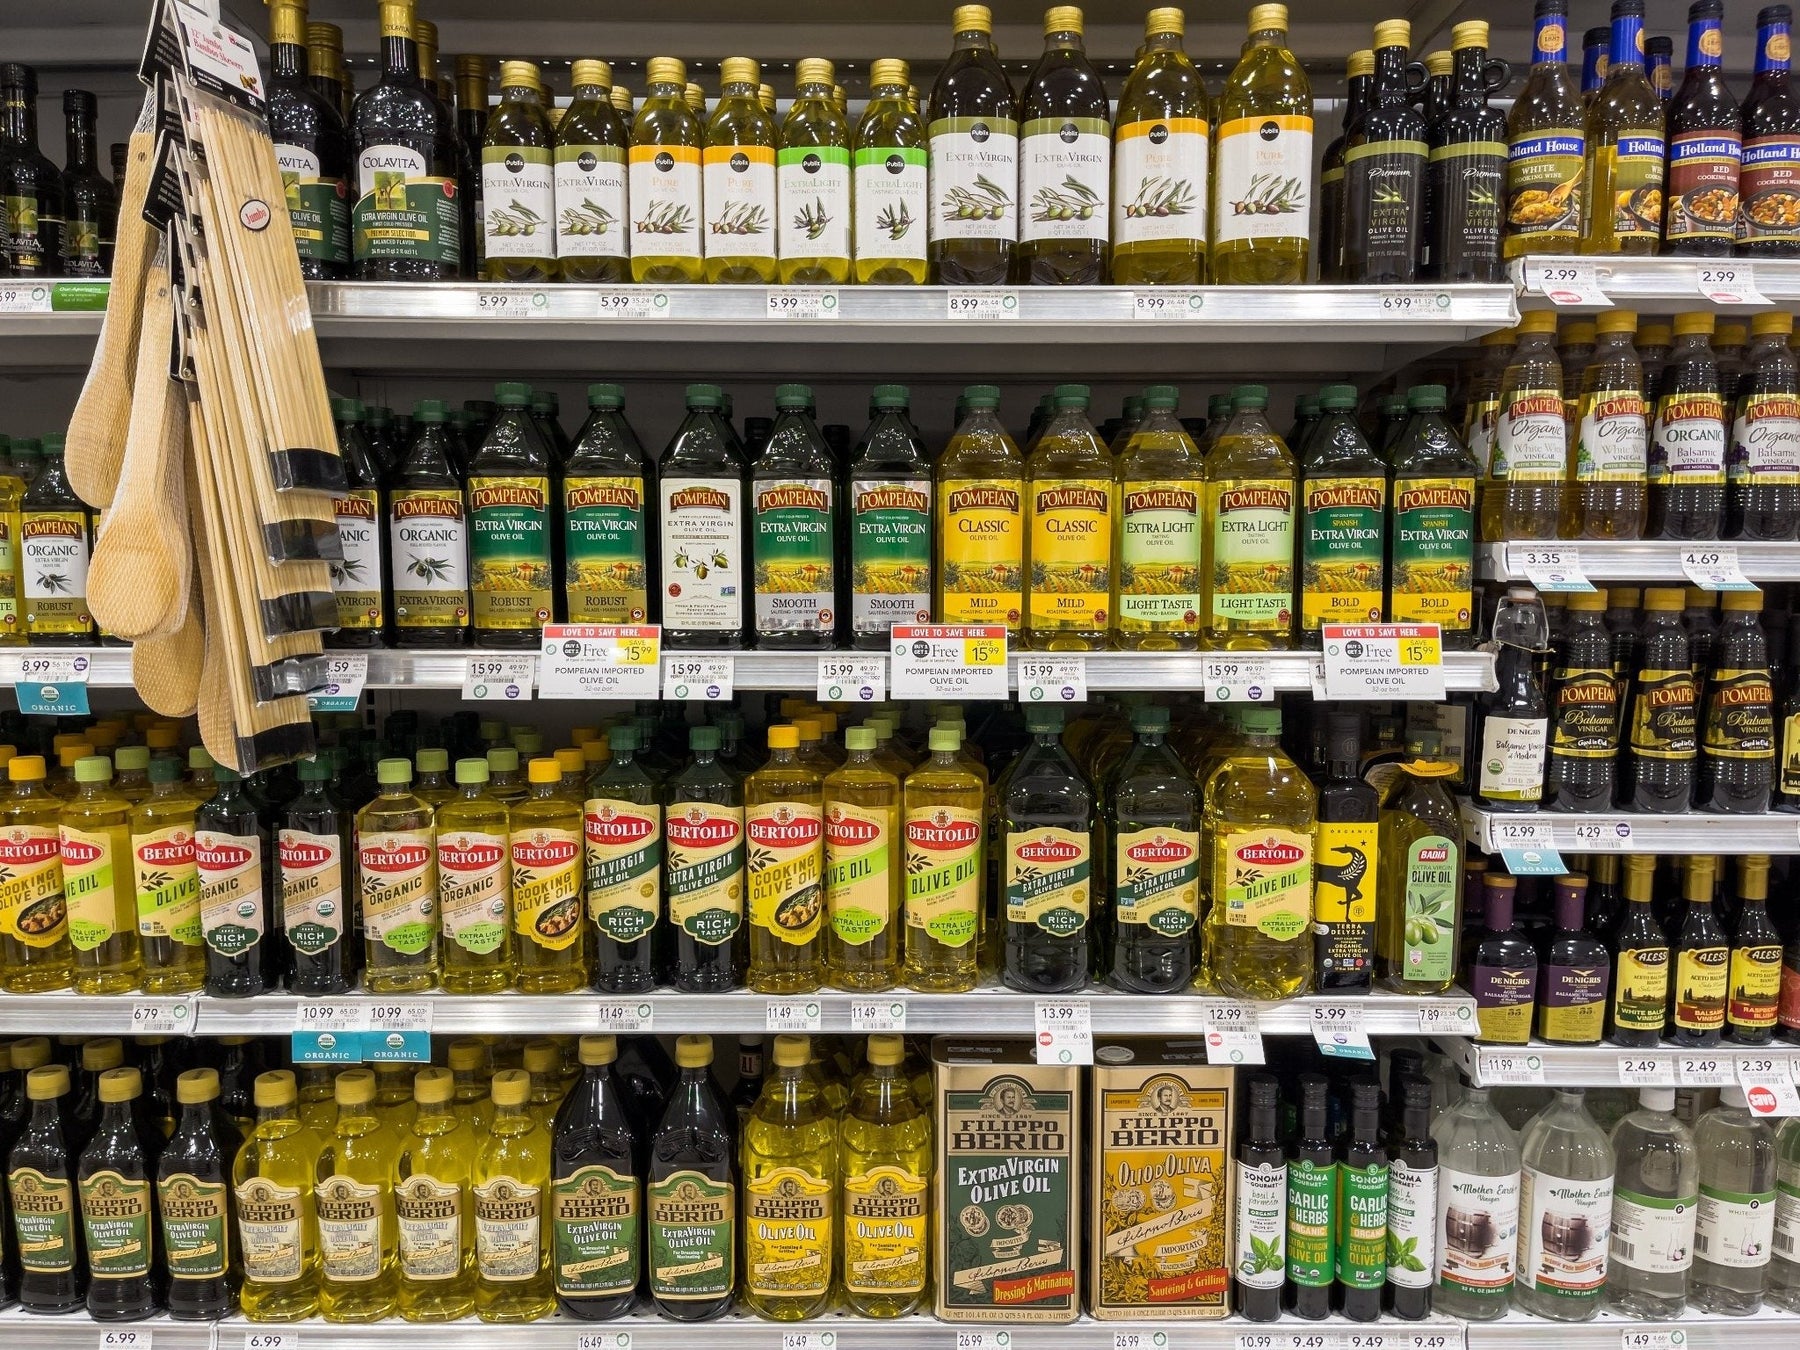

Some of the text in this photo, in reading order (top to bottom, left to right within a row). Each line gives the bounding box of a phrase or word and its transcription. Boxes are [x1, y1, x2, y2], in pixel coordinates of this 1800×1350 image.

[971, 129, 990, 137] Publix
[1510, 141, 1578, 157] olland House
[1680, 143, 1726, 157] Holland
[363, 156, 419, 170] COLAVITA
[1521, 163, 1555, 175] WHITE
[1713, 165, 1730, 173] RED
[1367, 166, 1412, 180] Premium
[1773, 170, 1793, 178] RED
[246, 209, 268, 225] Jumbo
[1373, 209, 1407, 218] EXTRA
[1371, 217, 1407, 226] VIRGIN
[1544, 269, 1577, 280] 2.99
[1702, 270, 1735, 282] 2.99
[1511, 419, 1562, 441] Organic
[1666, 429, 1723, 443] ORGANIC
[1677, 447, 1717, 458] Balsamic
[1757, 447, 1797, 459] Balsamic
[476, 488, 539, 506] POMPEIAN
[673, 491, 726, 507] POMPEIAN
[953, 491, 1015, 508] POMPEIAN
[1129, 493, 1193, 509] POMPEIAN
[1314, 491, 1378, 507] POMPEIAN
[397, 501, 458, 516] POMPEIAN
[475, 520, 542, 531] EXTRA VIRGIN
[958, 518, 1010, 534] CLASSIC
[1046, 518, 1098, 534] CLASSIC
[1126, 522, 1195, 534] EXTRA LIGHT
[400, 528, 457, 543] ORGANIC
[27, 545, 78, 557] ORGANIC
[1527, 553, 1561, 565] 3.35
[1686, 553, 1719, 565] 4.69
[37, 602, 73, 611] ROBUST
[490, 596, 532, 607] ROBUST
[772, 598, 817, 608] SMOOTH
[970, 598, 998, 609] MILD
[1057, 598, 1085, 609] MILD
[1126, 599, 1193, 609] LIGHT TASTE
[1331, 597, 1360, 607] BOLD
[563, 628, 641, 637] LOVE TO SAVE HERE.
[911, 629, 988, 637] LOVE TO SAVE HERE.
[1342, 628, 1421, 637] LOVE TO SAVE HERE.
[583, 644, 608, 657] Free
[555, 667, 645, 675] POMPEIAN IMPORTED
[905, 668, 993, 676] POMPEIAN IMPORTED
[1577, 725, 1608, 733] VINEGAR
[1740, 725, 1769, 734] VINEGAR
[751, 823, 819, 839] BERTOLLI
[909, 826, 976, 842] BERTOLLI
[1502, 826, 1535, 838] 12.99
[0, 841, 59, 858] ERTOLLI
[513, 845, 574, 860] BERTOLLI
[1021, 847, 1077, 858] BERTOLLI
[1133, 847, 1187, 858] BERTOLLI
[1420, 850, 1446, 860] BADIA
[363, 849, 428, 865] BERTOLLI
[755, 854, 816, 887] COOKING
[1411, 870, 1452, 884] OLIVE OIL
[370, 876, 422, 906] ORGANIC
[518, 871, 571, 901] COOKING
[696, 918, 731, 929] RICH
[1048, 916, 1076, 924] RICH
[1158, 916, 1187, 924] RICH
[216, 933, 246, 942] RICH
[388, 933, 413, 941] EXTRA
[701, 928, 727, 936] TASTE
[942, 927, 972, 936] TASTE
[1490, 976, 1531, 985] DE NIGRIS
[1575, 976, 1601, 984] NIGRIS
[1041, 1008, 1073, 1019] 13.99
[1209, 1009, 1241, 1020] 12.99
[1314, 1008, 1346, 1019] 5.99
[304, 1051, 350, 1060] ORGANIC
[373, 1050, 419, 1059] ORGANIC
[1624, 1061, 1656, 1073] 2.49
[1686, 1061, 1717, 1073] 2.49
[1742, 1060, 1772, 1073] 2.39
[960, 1119, 1058, 1132] FILIPPO
[1119, 1117, 1213, 1129] FILIPPO
[952, 1132, 1065, 1150] BERIO
[1111, 1129, 1219, 1147] BERIO
[1244, 1171, 1283, 1182] SONOMA
[1350, 1174, 1388, 1184] SONOMA
[970, 1174, 1050, 1205] OLIVE OIL
[1459, 1182, 1494, 1195] Mother
[1556, 1187, 1592, 1199] Mother
[479, 1200, 532, 1209] FILIPPO
[564, 1196, 626, 1207] FILIPPO
[758, 1198, 820, 1208] FILIPPO
[857, 1197, 918, 1206] FILIPPO
[1289, 1189, 1329, 1209] GARLIC
[1477, 1195, 1500, 1203] Vinegar
[560, 1204, 630, 1218] BERIO
[659, 1202, 719, 1211] FILIPPO
[754, 1206, 823, 1219] BERIO
[852, 1204, 920, 1217] BERIO
[655, 1209, 723, 1223] BERIO
[1295, 1208, 1328, 1225] HERBS
[1161, 1239, 1204, 1255] IMPORTATO
[995, 1275, 1073, 1302] Dressing & Marinating
[106, 1333, 136, 1344] 6.99
[251, 1335, 281, 1347] 6.99
[1240, 1336, 1271, 1348] 10.99
[1293, 1336, 1323, 1348] 9.49
[1352, 1336, 1383, 1348] 9.49
